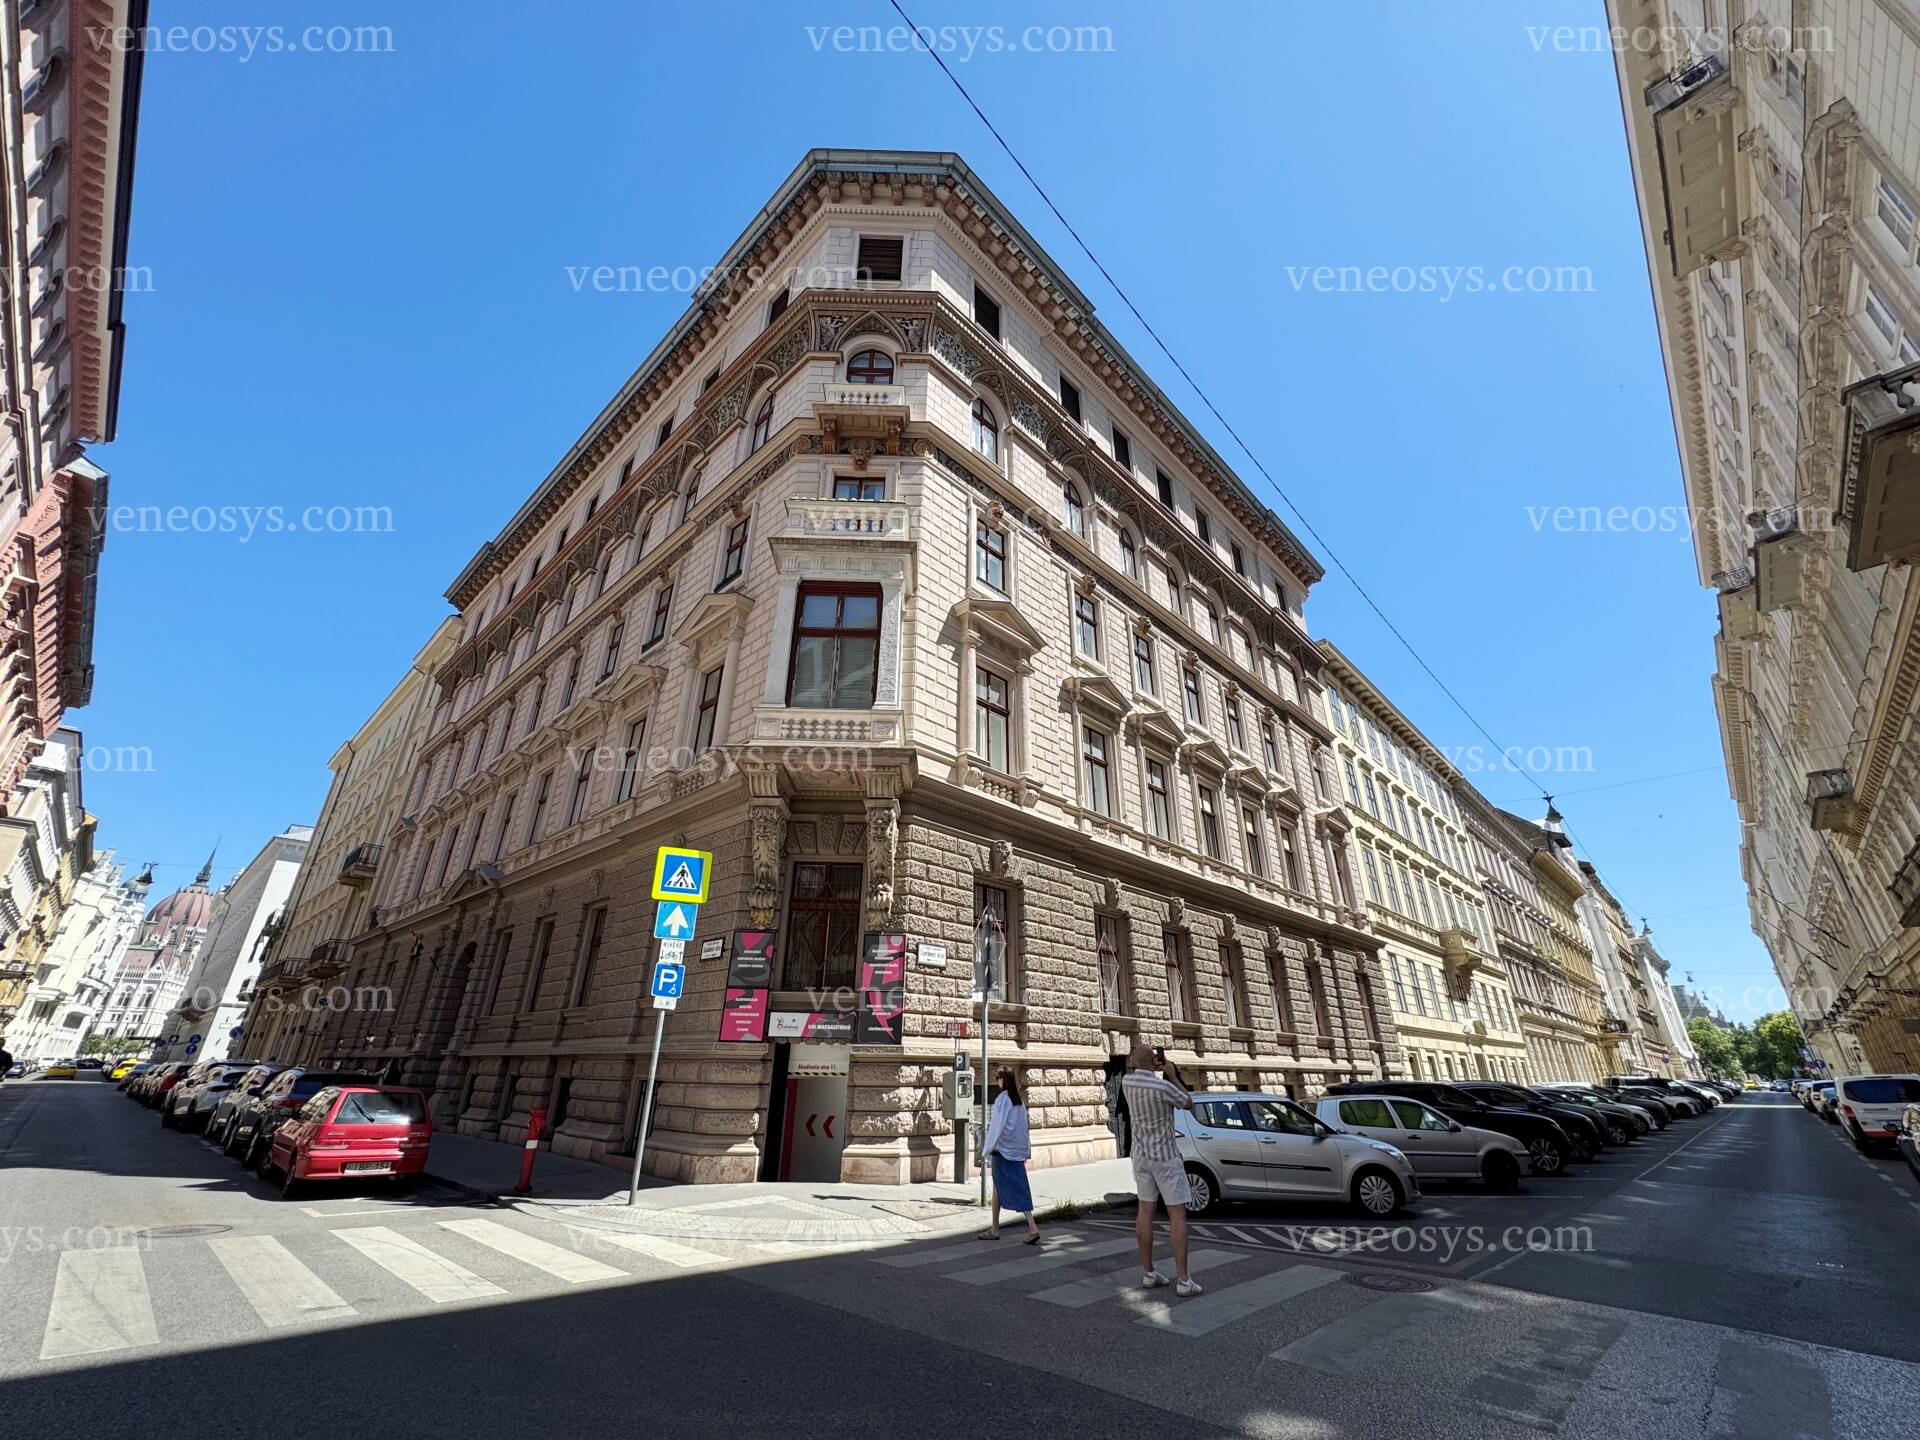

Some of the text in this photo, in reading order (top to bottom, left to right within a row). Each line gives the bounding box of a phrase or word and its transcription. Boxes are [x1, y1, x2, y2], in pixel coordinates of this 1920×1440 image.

[663, 941, 683, 949] KIVÉVE
[658, 968, 678, 991] P
[956, 1054, 963, 1068] P
